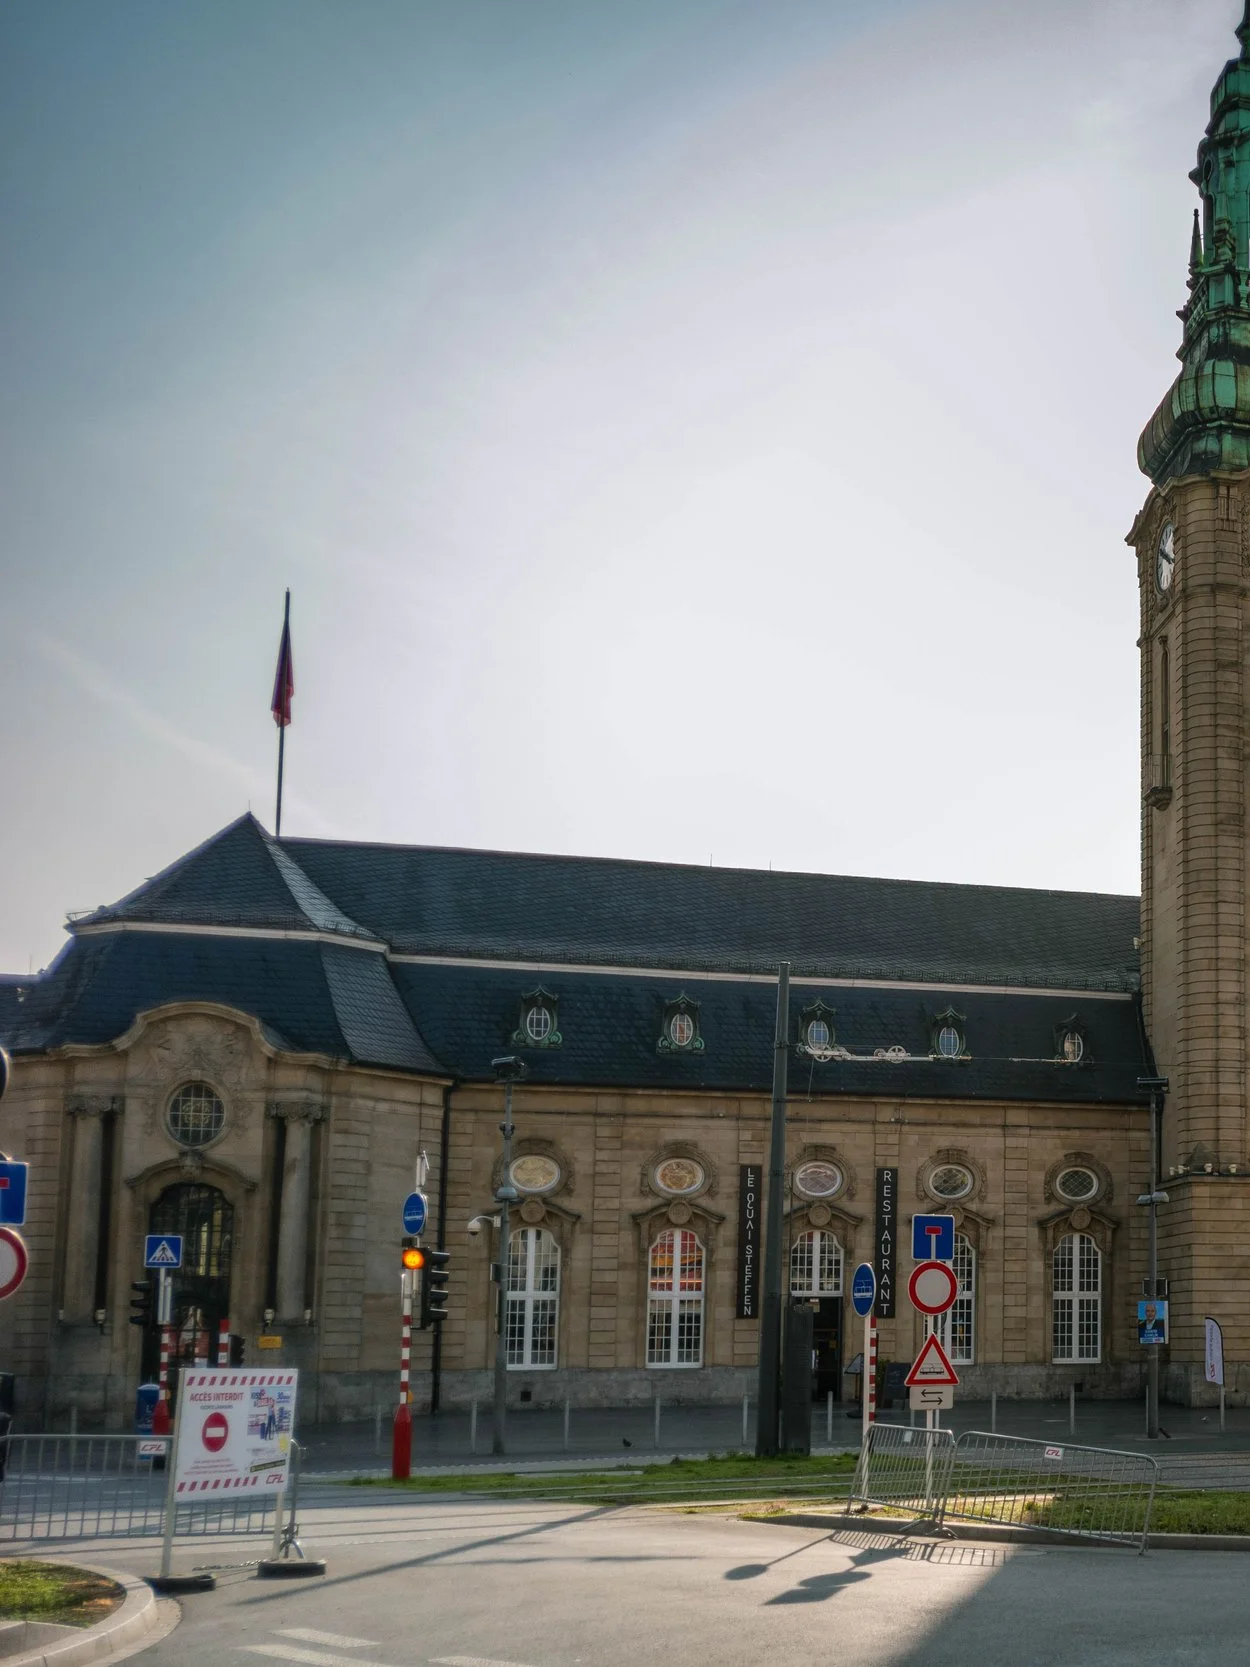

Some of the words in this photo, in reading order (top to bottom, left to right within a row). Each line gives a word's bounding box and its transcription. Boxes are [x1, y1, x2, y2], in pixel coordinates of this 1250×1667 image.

[747, 1167, 755, 1187] LE
[746, 1192, 754, 1240] QUAI
[880, 1170, 892, 1315] RESTAURANT
[743, 1244, 753, 1316] STEFFEN
[213, 1392, 245, 1401] INTERDIT
[141, 1444, 164, 1452] CFL
[1046, 1448, 1061, 1456] CFL
[265, 1474, 284, 1484] CFL
